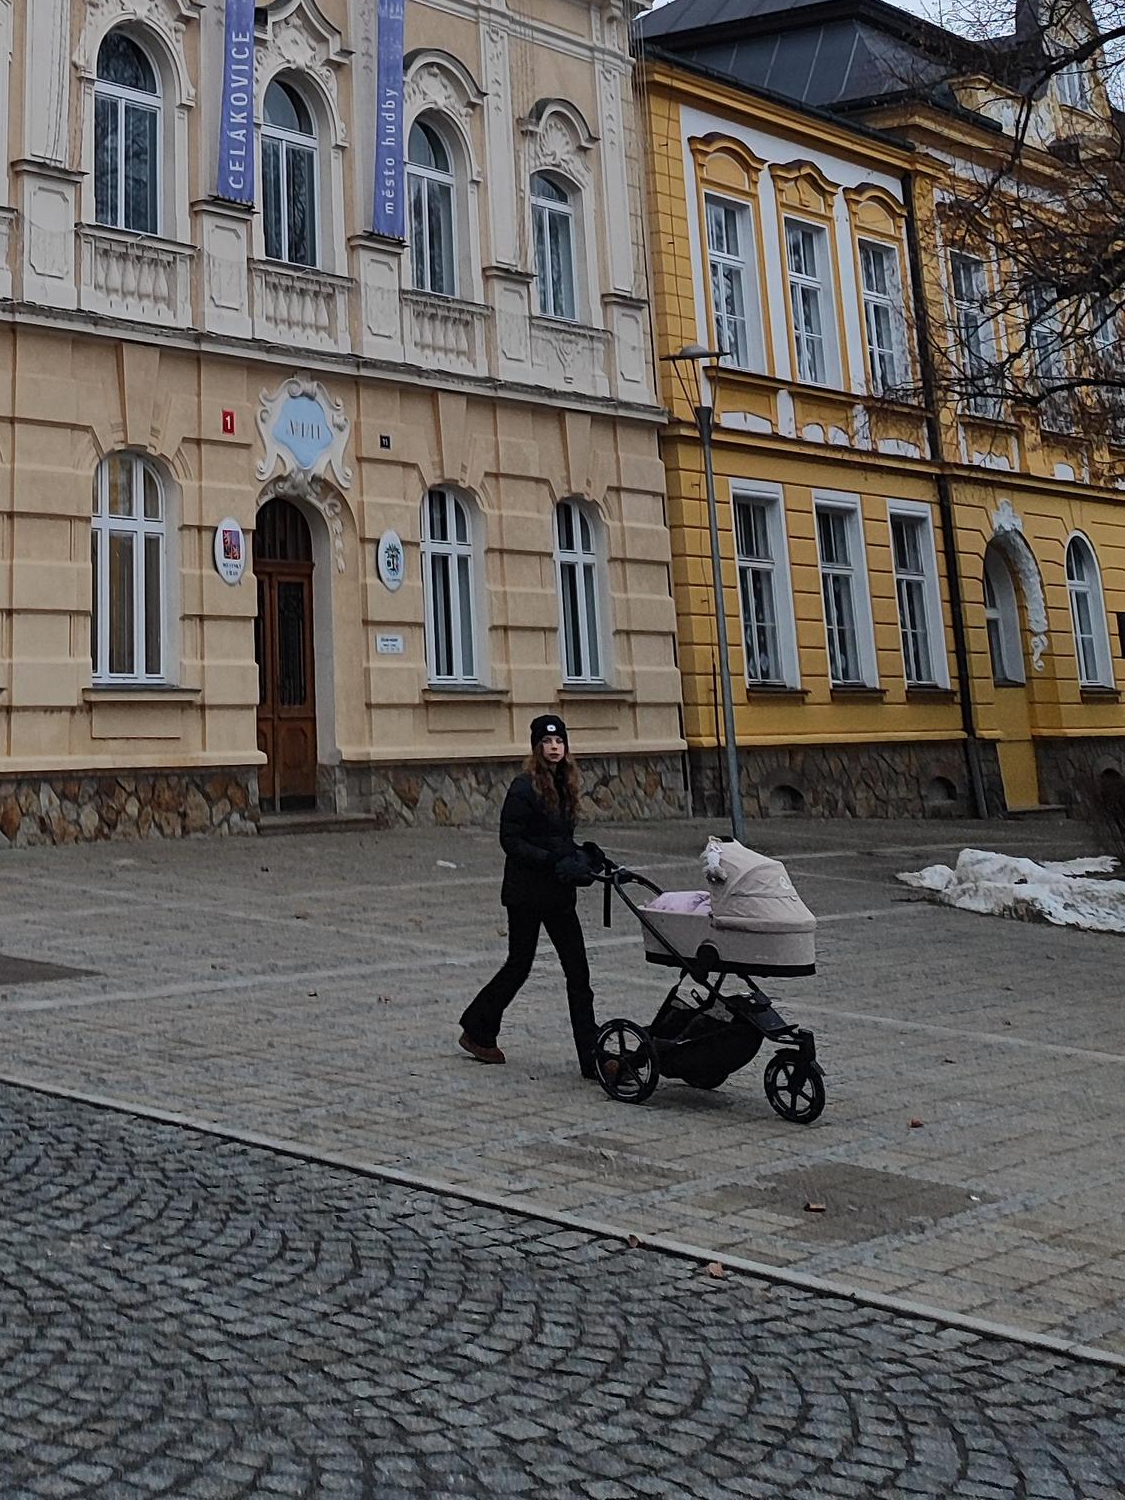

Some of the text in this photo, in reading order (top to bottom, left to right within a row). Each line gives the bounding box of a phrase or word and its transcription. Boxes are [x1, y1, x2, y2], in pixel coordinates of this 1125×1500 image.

[381, 88, 399, 215] město hudby
[225, 414, 231, 430] 1
